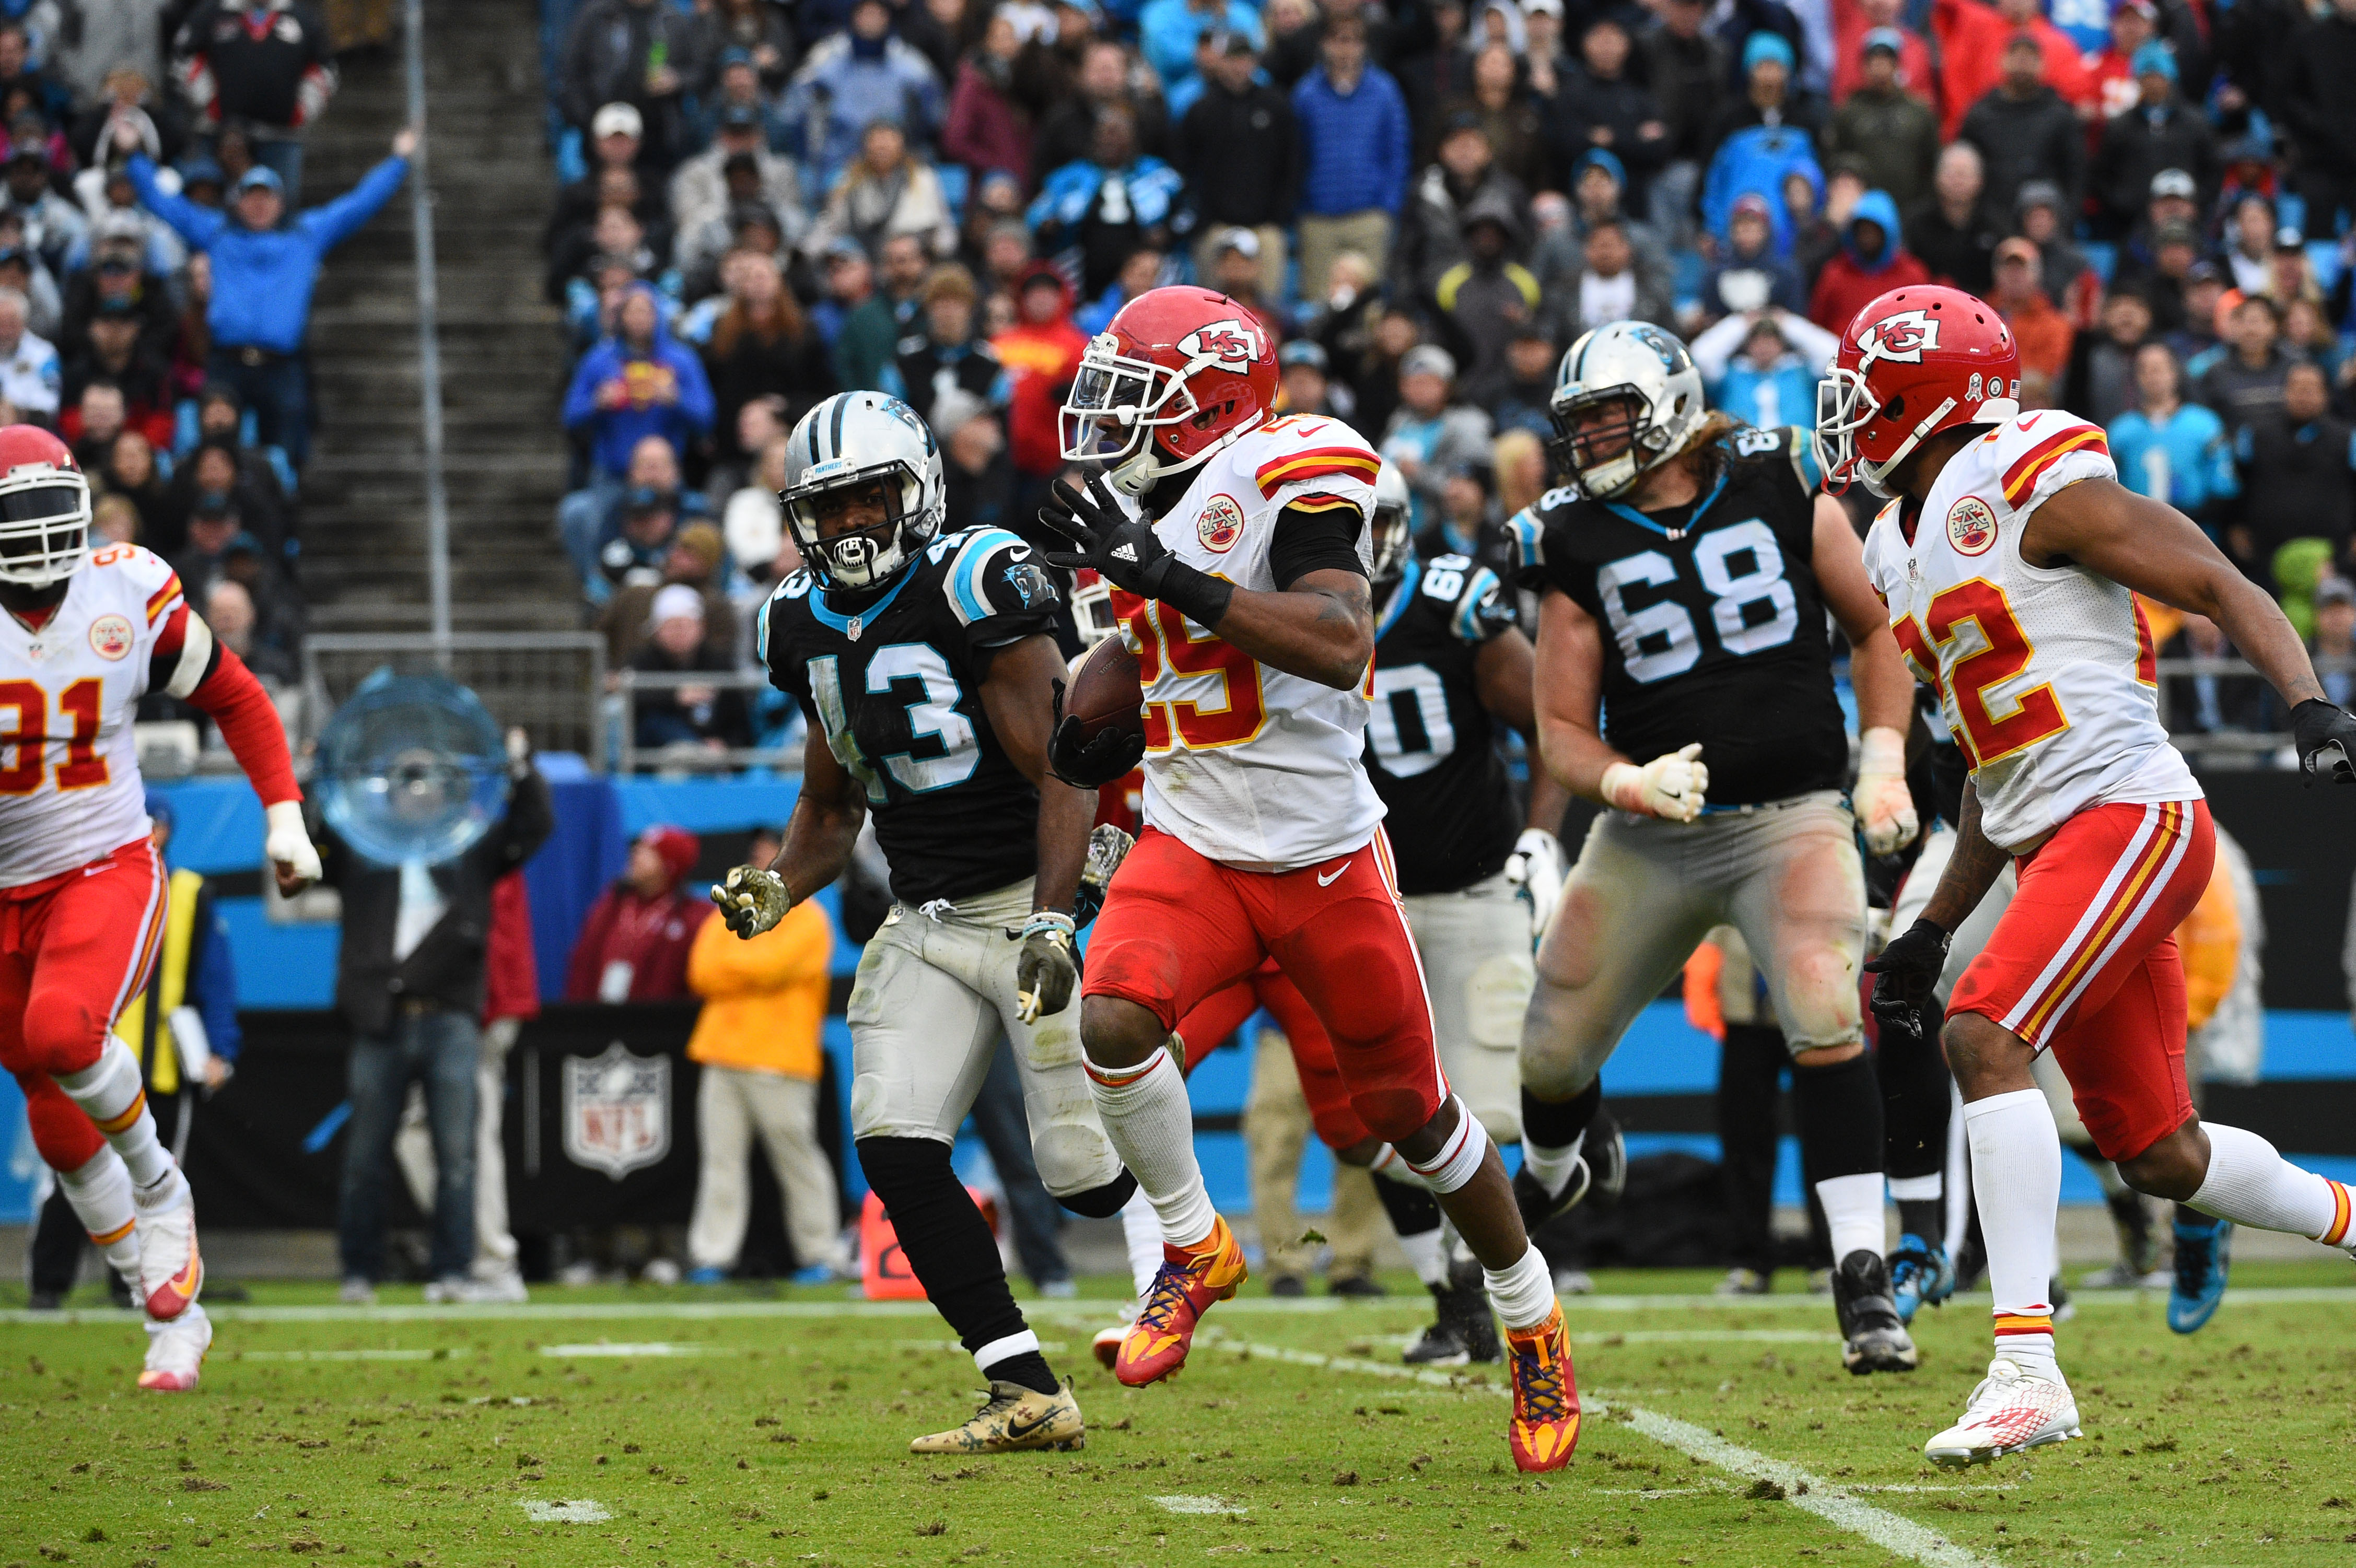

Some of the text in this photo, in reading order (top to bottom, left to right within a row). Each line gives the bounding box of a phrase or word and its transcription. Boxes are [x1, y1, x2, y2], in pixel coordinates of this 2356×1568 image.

[1196, 330, 1250, 362] KC
[1874, 321, 1926, 353] KC
[815, 461, 842, 474] PANTHERS
[1203, 501, 1238, 536] A
[1954, 504, 1990, 539] A
[1111, 551, 1138, 562] adidas
[1596, 517, 1800, 685] 68
[850, 626, 860, 637] NFL
[581, 1102, 658, 1152] NFL
